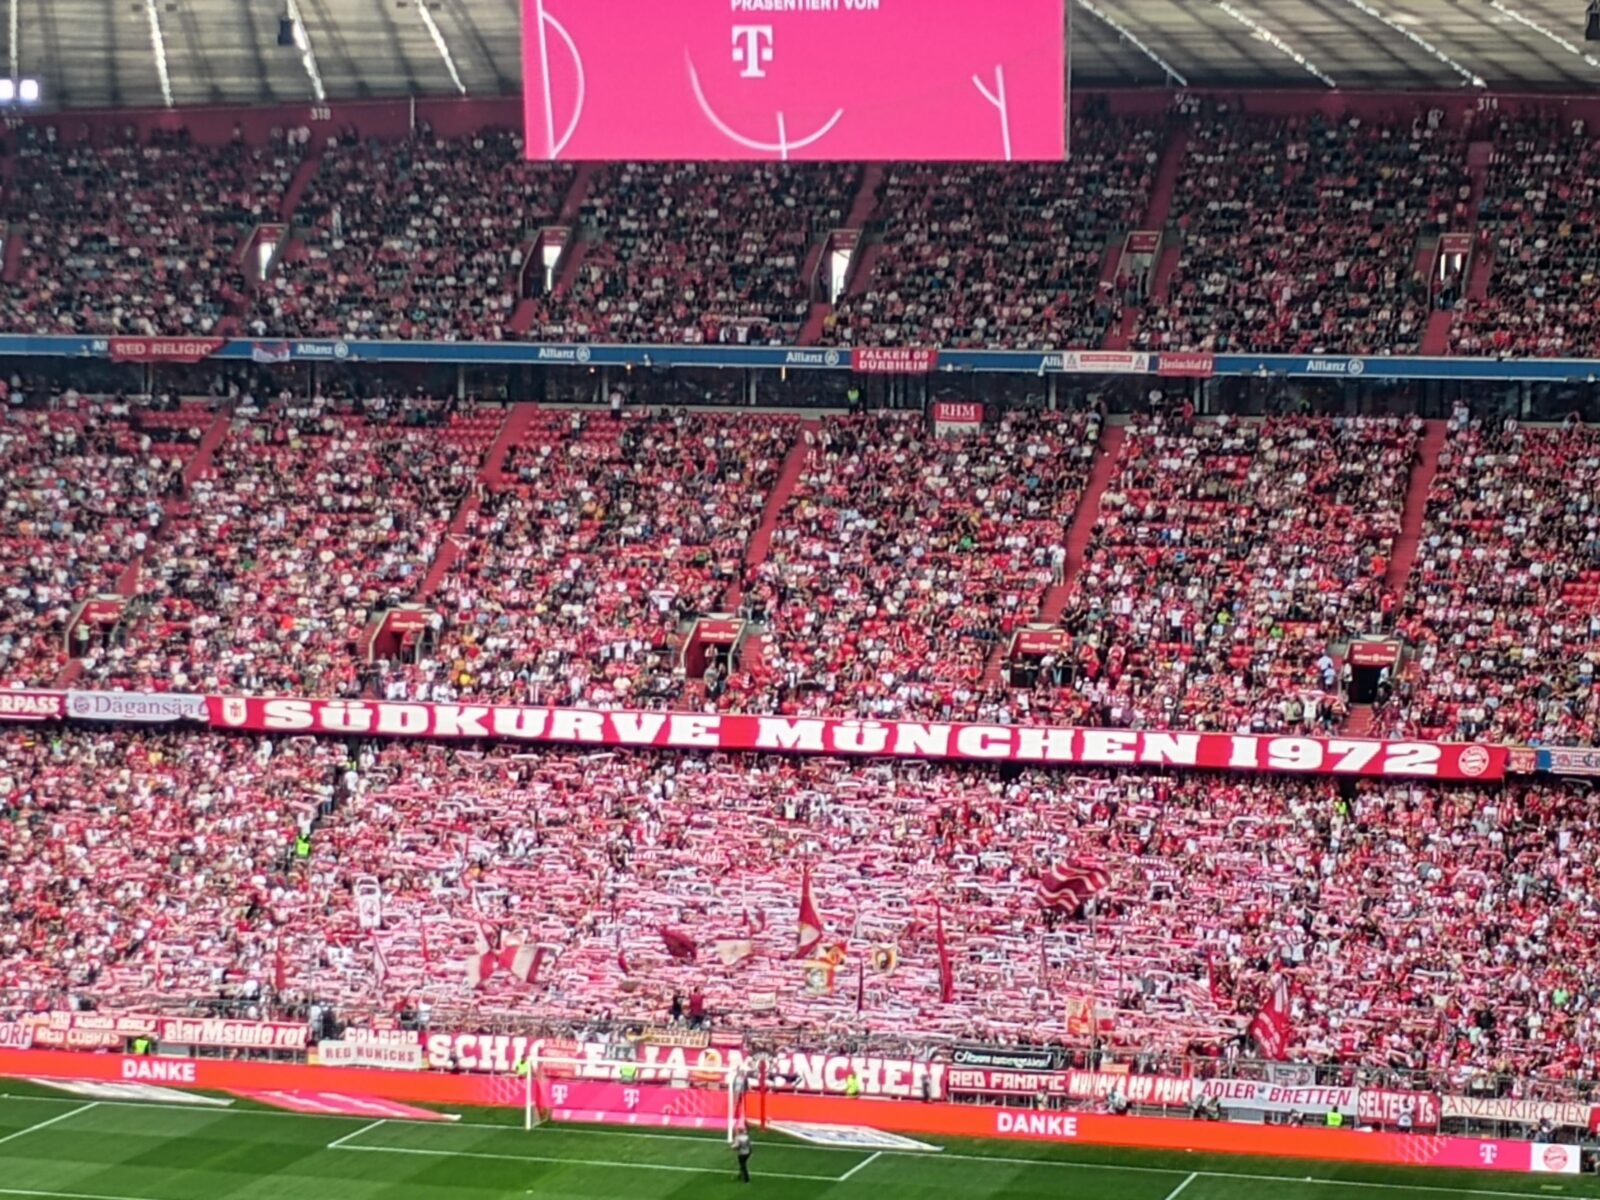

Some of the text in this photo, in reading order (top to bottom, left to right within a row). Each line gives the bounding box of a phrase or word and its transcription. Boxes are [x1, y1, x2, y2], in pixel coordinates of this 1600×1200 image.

[115, 342, 215, 355] RED RELIGIO
[297, 344, 332, 354] Allianz
[538, 348, 574, 359] Allianz
[860, 350, 910, 360] FALKEN
[786, 352, 822, 363] Allianz
[1306, 360, 1346, 372] Allianz
[940, 403, 975, 417] RHM
[263, 699, 720, 746] SÜDKURVE
[755, 716, 1200, 764] MÜNCHEN
[1229, 734, 1440, 775] 1972
[275, 1025, 308, 1047] rot
[325, 1047, 351, 1059] RED
[122, 1059, 196, 1082] DANKE
[1201, 1081, 1351, 1106] ADLER BRETTEN
[1446, 1095, 1588, 1124] ANZENKIRCHEN
[997, 1112, 1077, 1137] DANKE
